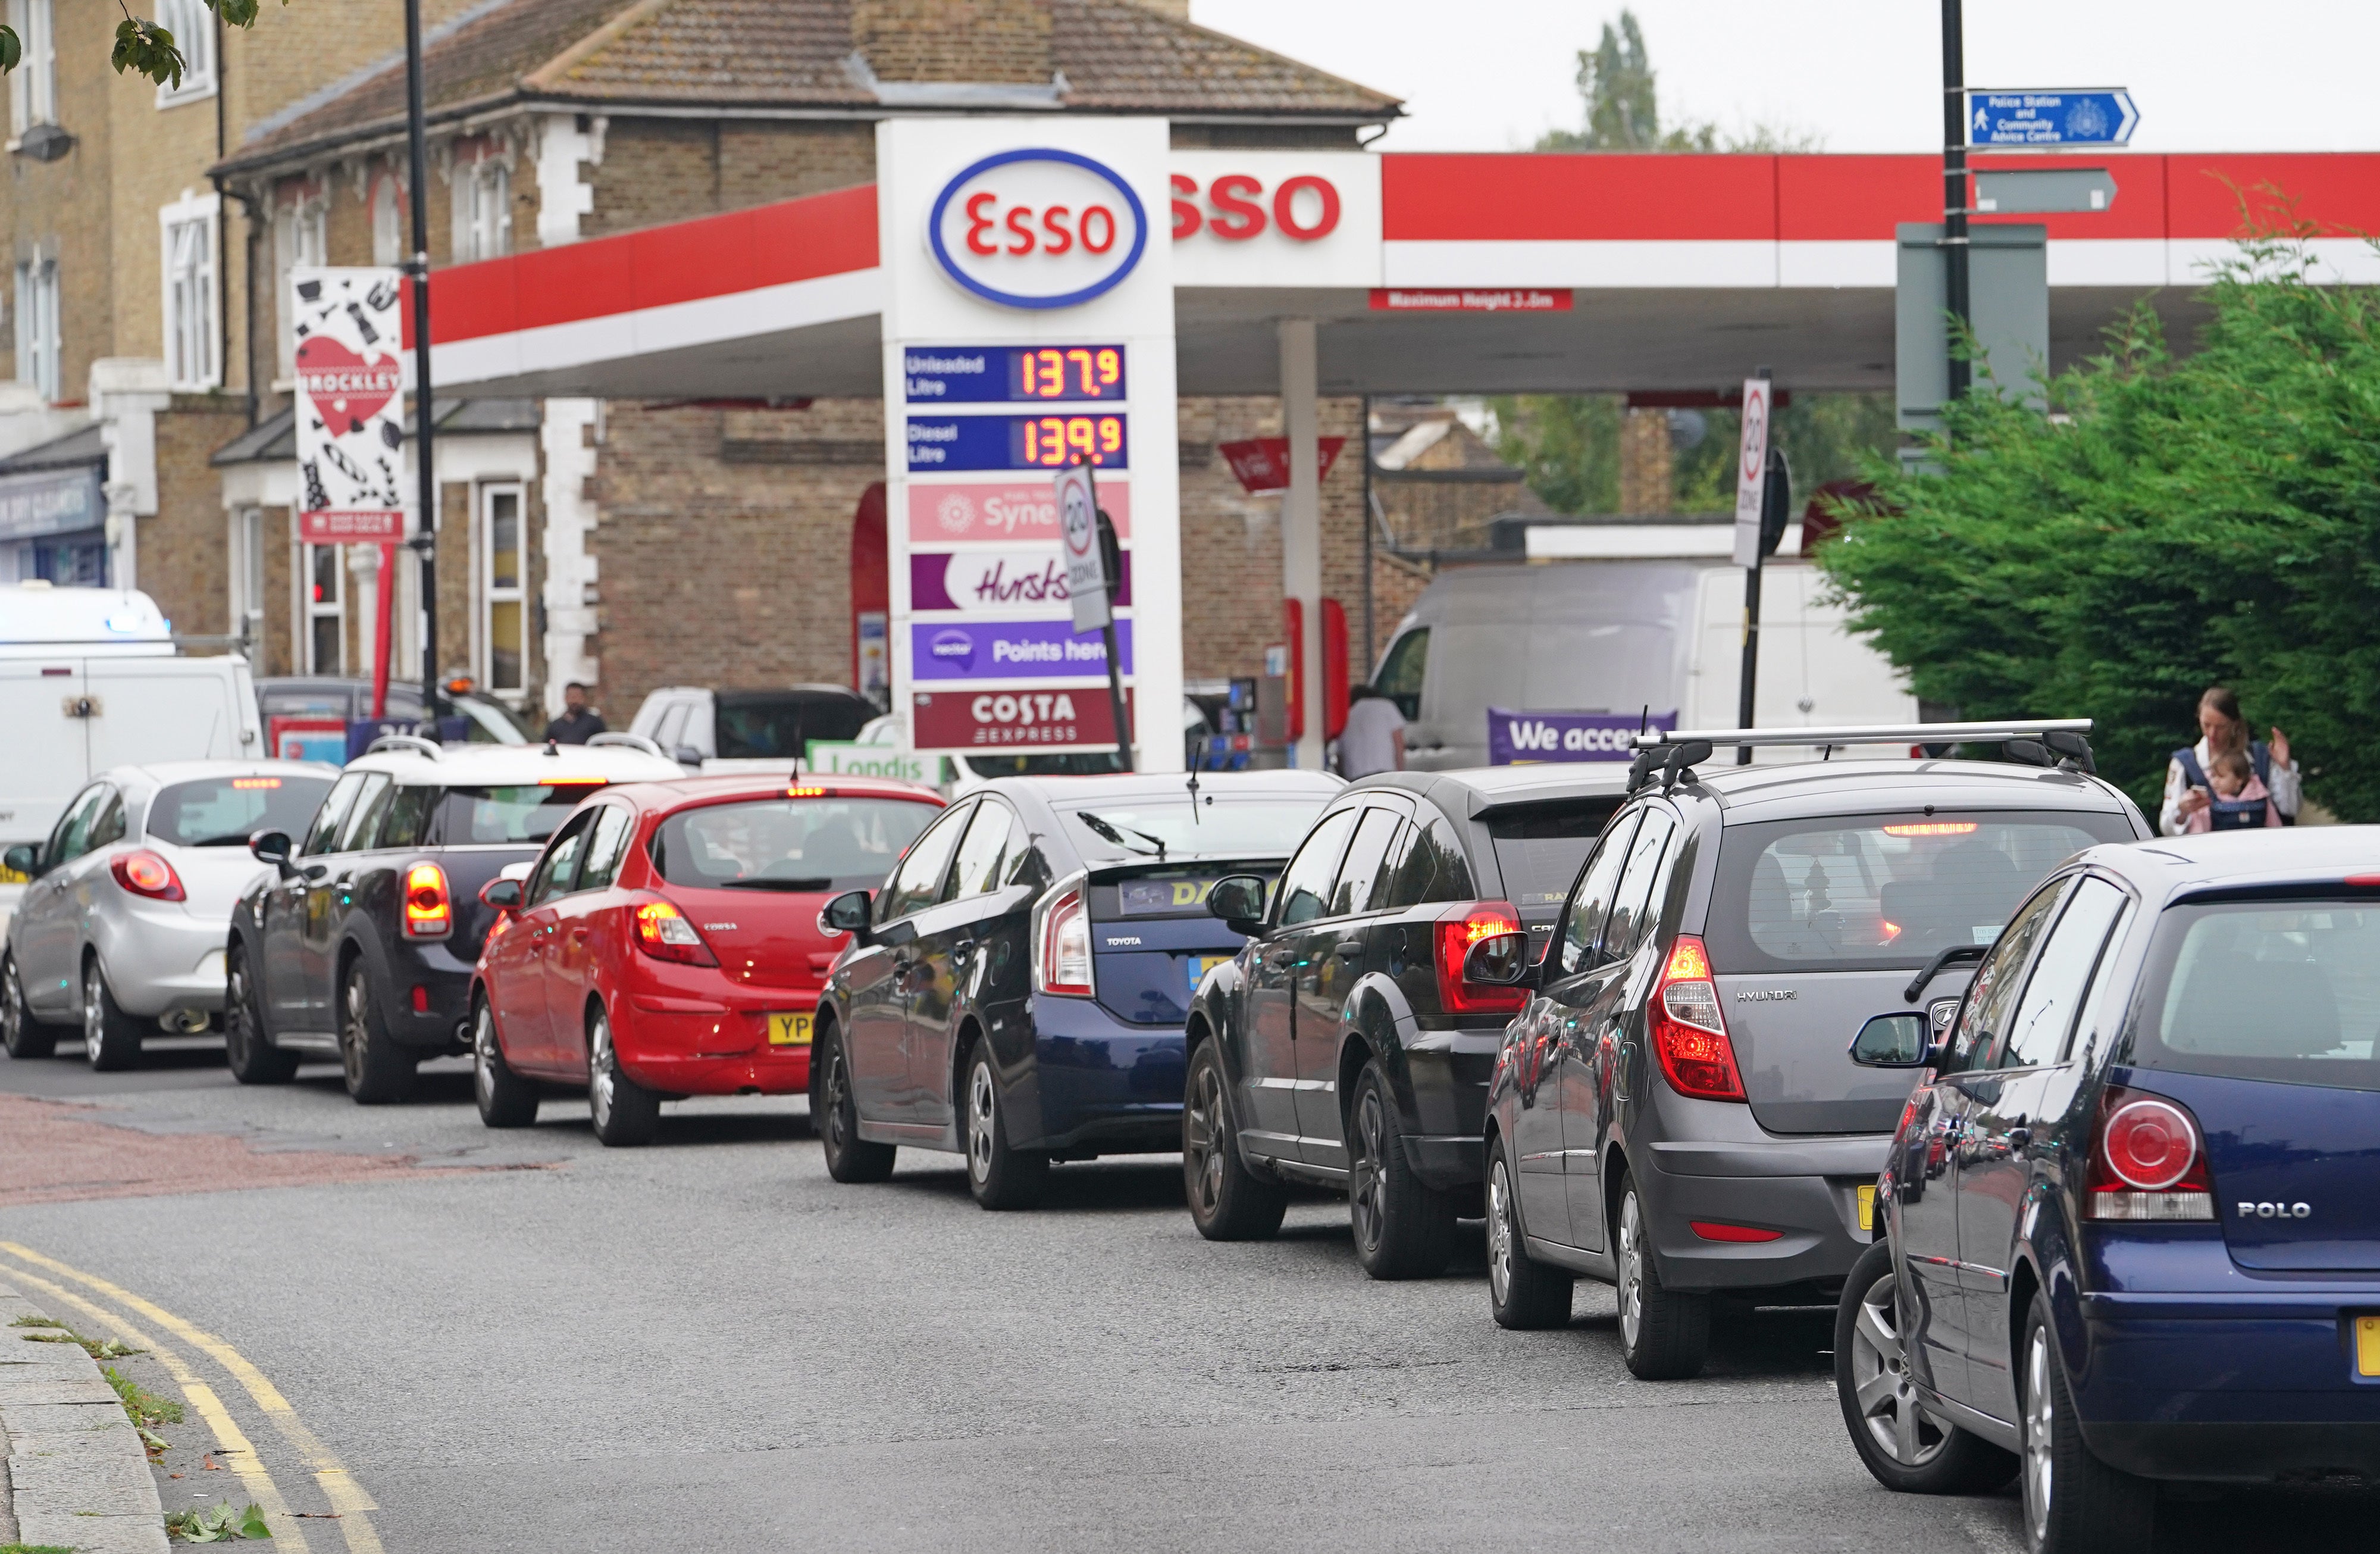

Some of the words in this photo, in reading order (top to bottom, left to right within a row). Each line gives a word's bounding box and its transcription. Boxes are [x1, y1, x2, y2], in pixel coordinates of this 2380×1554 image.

[1989, 96, 2021, 107] Police
[2024, 96, 2060, 107] Station
[2015, 108, 2036, 119] and
[1997, 119, 2053, 131] Community
[1991, 132, 2025, 142] Advice
[2026, 131, 2061, 142] Centre
[1388, 291, 1460, 307] Maximum
[1462, 291, 1511, 311] Height
[906, 355, 985, 374] Unleaded
[1022, 348, 1120, 397] 137.9
[300, 373, 399, 392] BROCKLEY
[906, 378, 946, 396] Litre
[908, 424, 958, 442] Diesel
[908, 446, 946, 463] Litre
[984, 496, 1056, 534] Syne
[974, 559, 1070, 601] Hursts
[1070, 562, 1097, 586] ZONE
[933, 643, 971, 656] nectar
[992, 639, 1063, 663] Points
[971, 693, 1076, 726] COSTA
[986, 726, 1077, 743] EXPRESS
[1509, 720, 1559, 751] We
[704, 923, 737, 931] CORSA
[1107, 937, 1141, 946] TOYOTA
[1737, 989, 1797, 1002] HYUNDAI
[781, 1017, 808, 1037] YP
[2237, 1202, 2312, 1219] POLO
